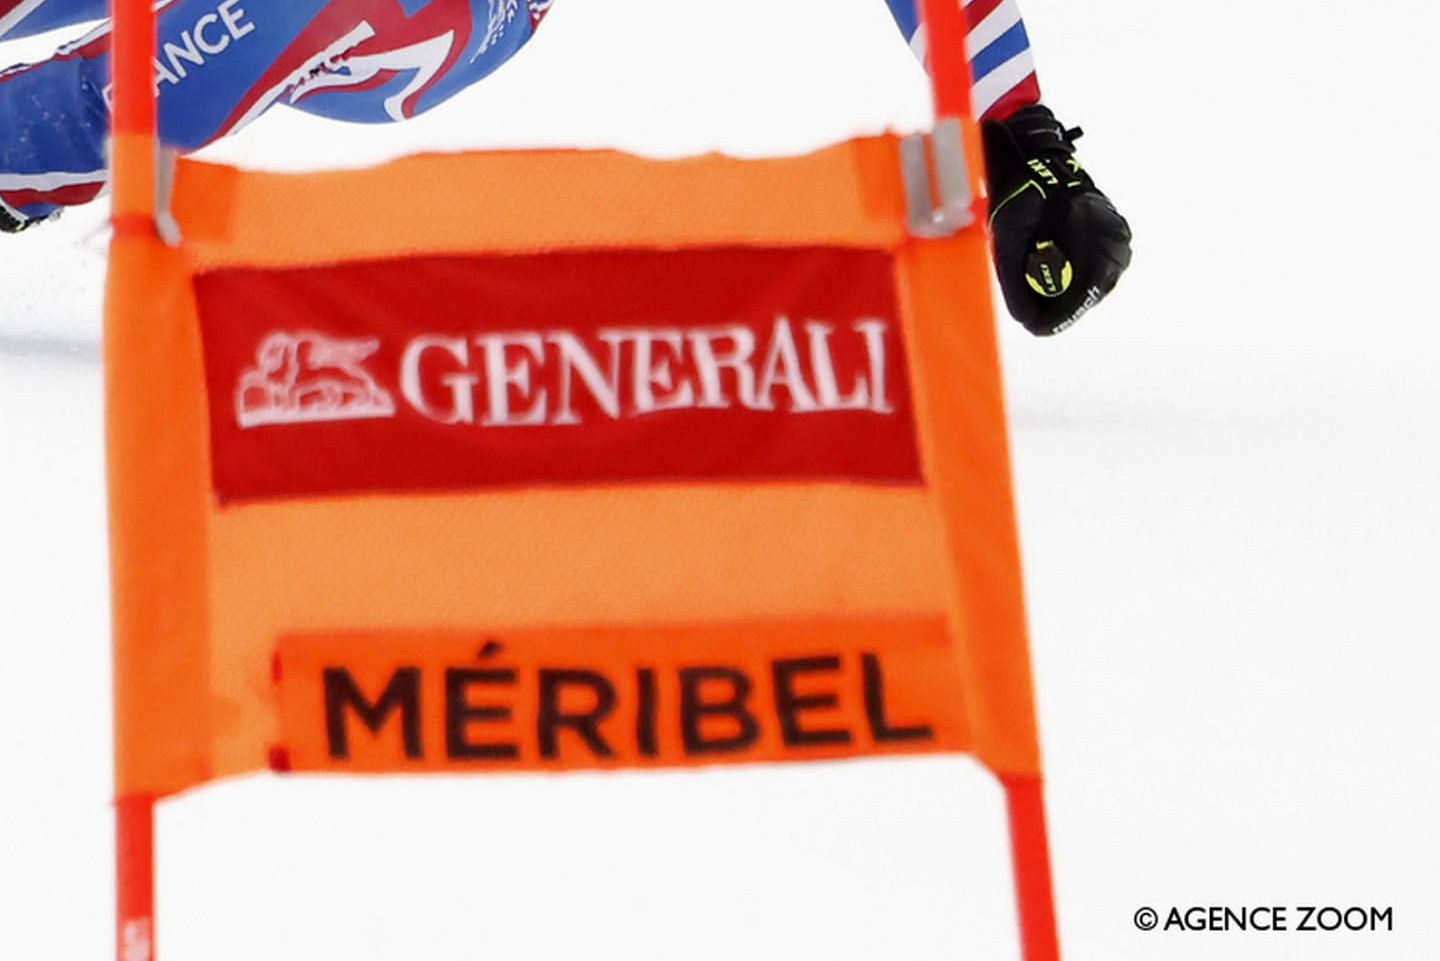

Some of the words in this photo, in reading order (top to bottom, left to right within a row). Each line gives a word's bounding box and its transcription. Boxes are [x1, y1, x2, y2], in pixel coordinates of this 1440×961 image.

[1027, 158, 1059, 186] LEKI
[1040, 263, 1057, 293] LEKI
[398, 315, 894, 427] GENERALI
[323, 641, 933, 761] MÉRIBEL
